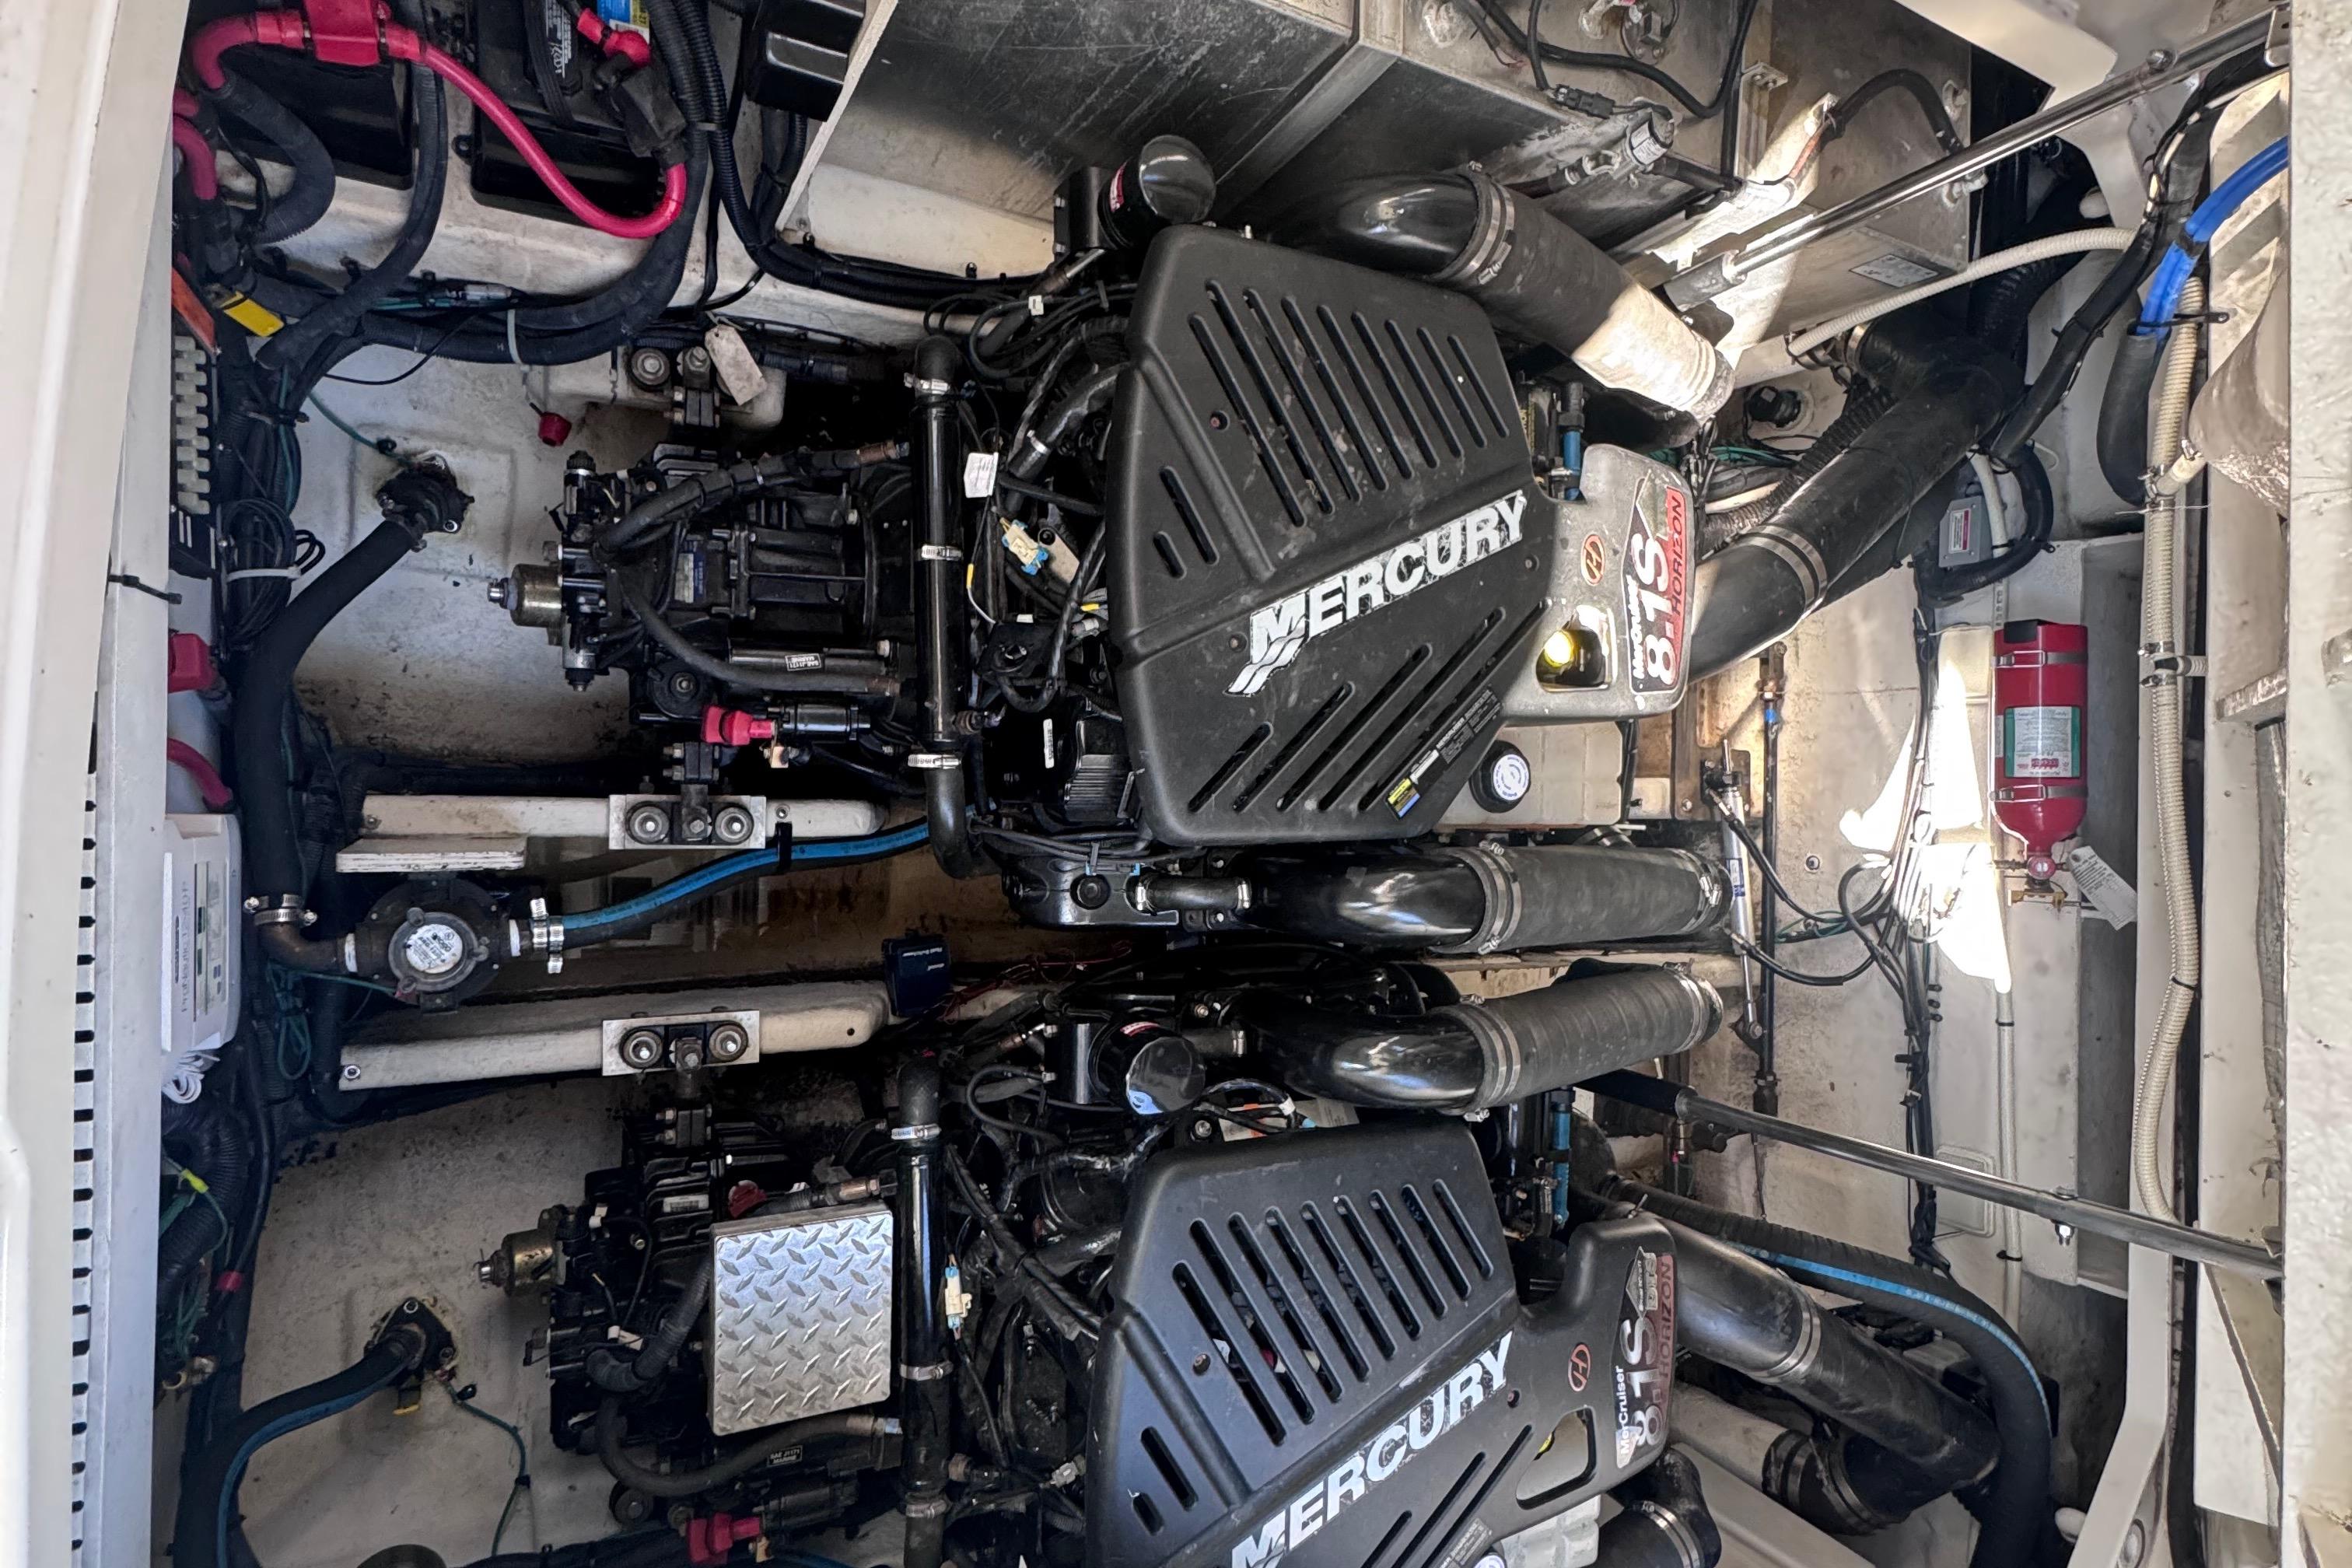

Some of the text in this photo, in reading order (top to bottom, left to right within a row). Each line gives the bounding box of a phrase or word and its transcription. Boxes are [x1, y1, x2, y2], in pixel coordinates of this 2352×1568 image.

[1249, 492, 1527, 664] MERCURY
[1631, 533, 1676, 684] 8.1S
[1671, 495, 1682, 616] HORIZON
[1619, 1318, 1663, 1446] 8.1S
[1658, 1261, 1672, 1377] HORIZON
[1231, 1330, 1513, 1568] MERCURY
[1615, 1365, 1629, 1454] MerCruiser
